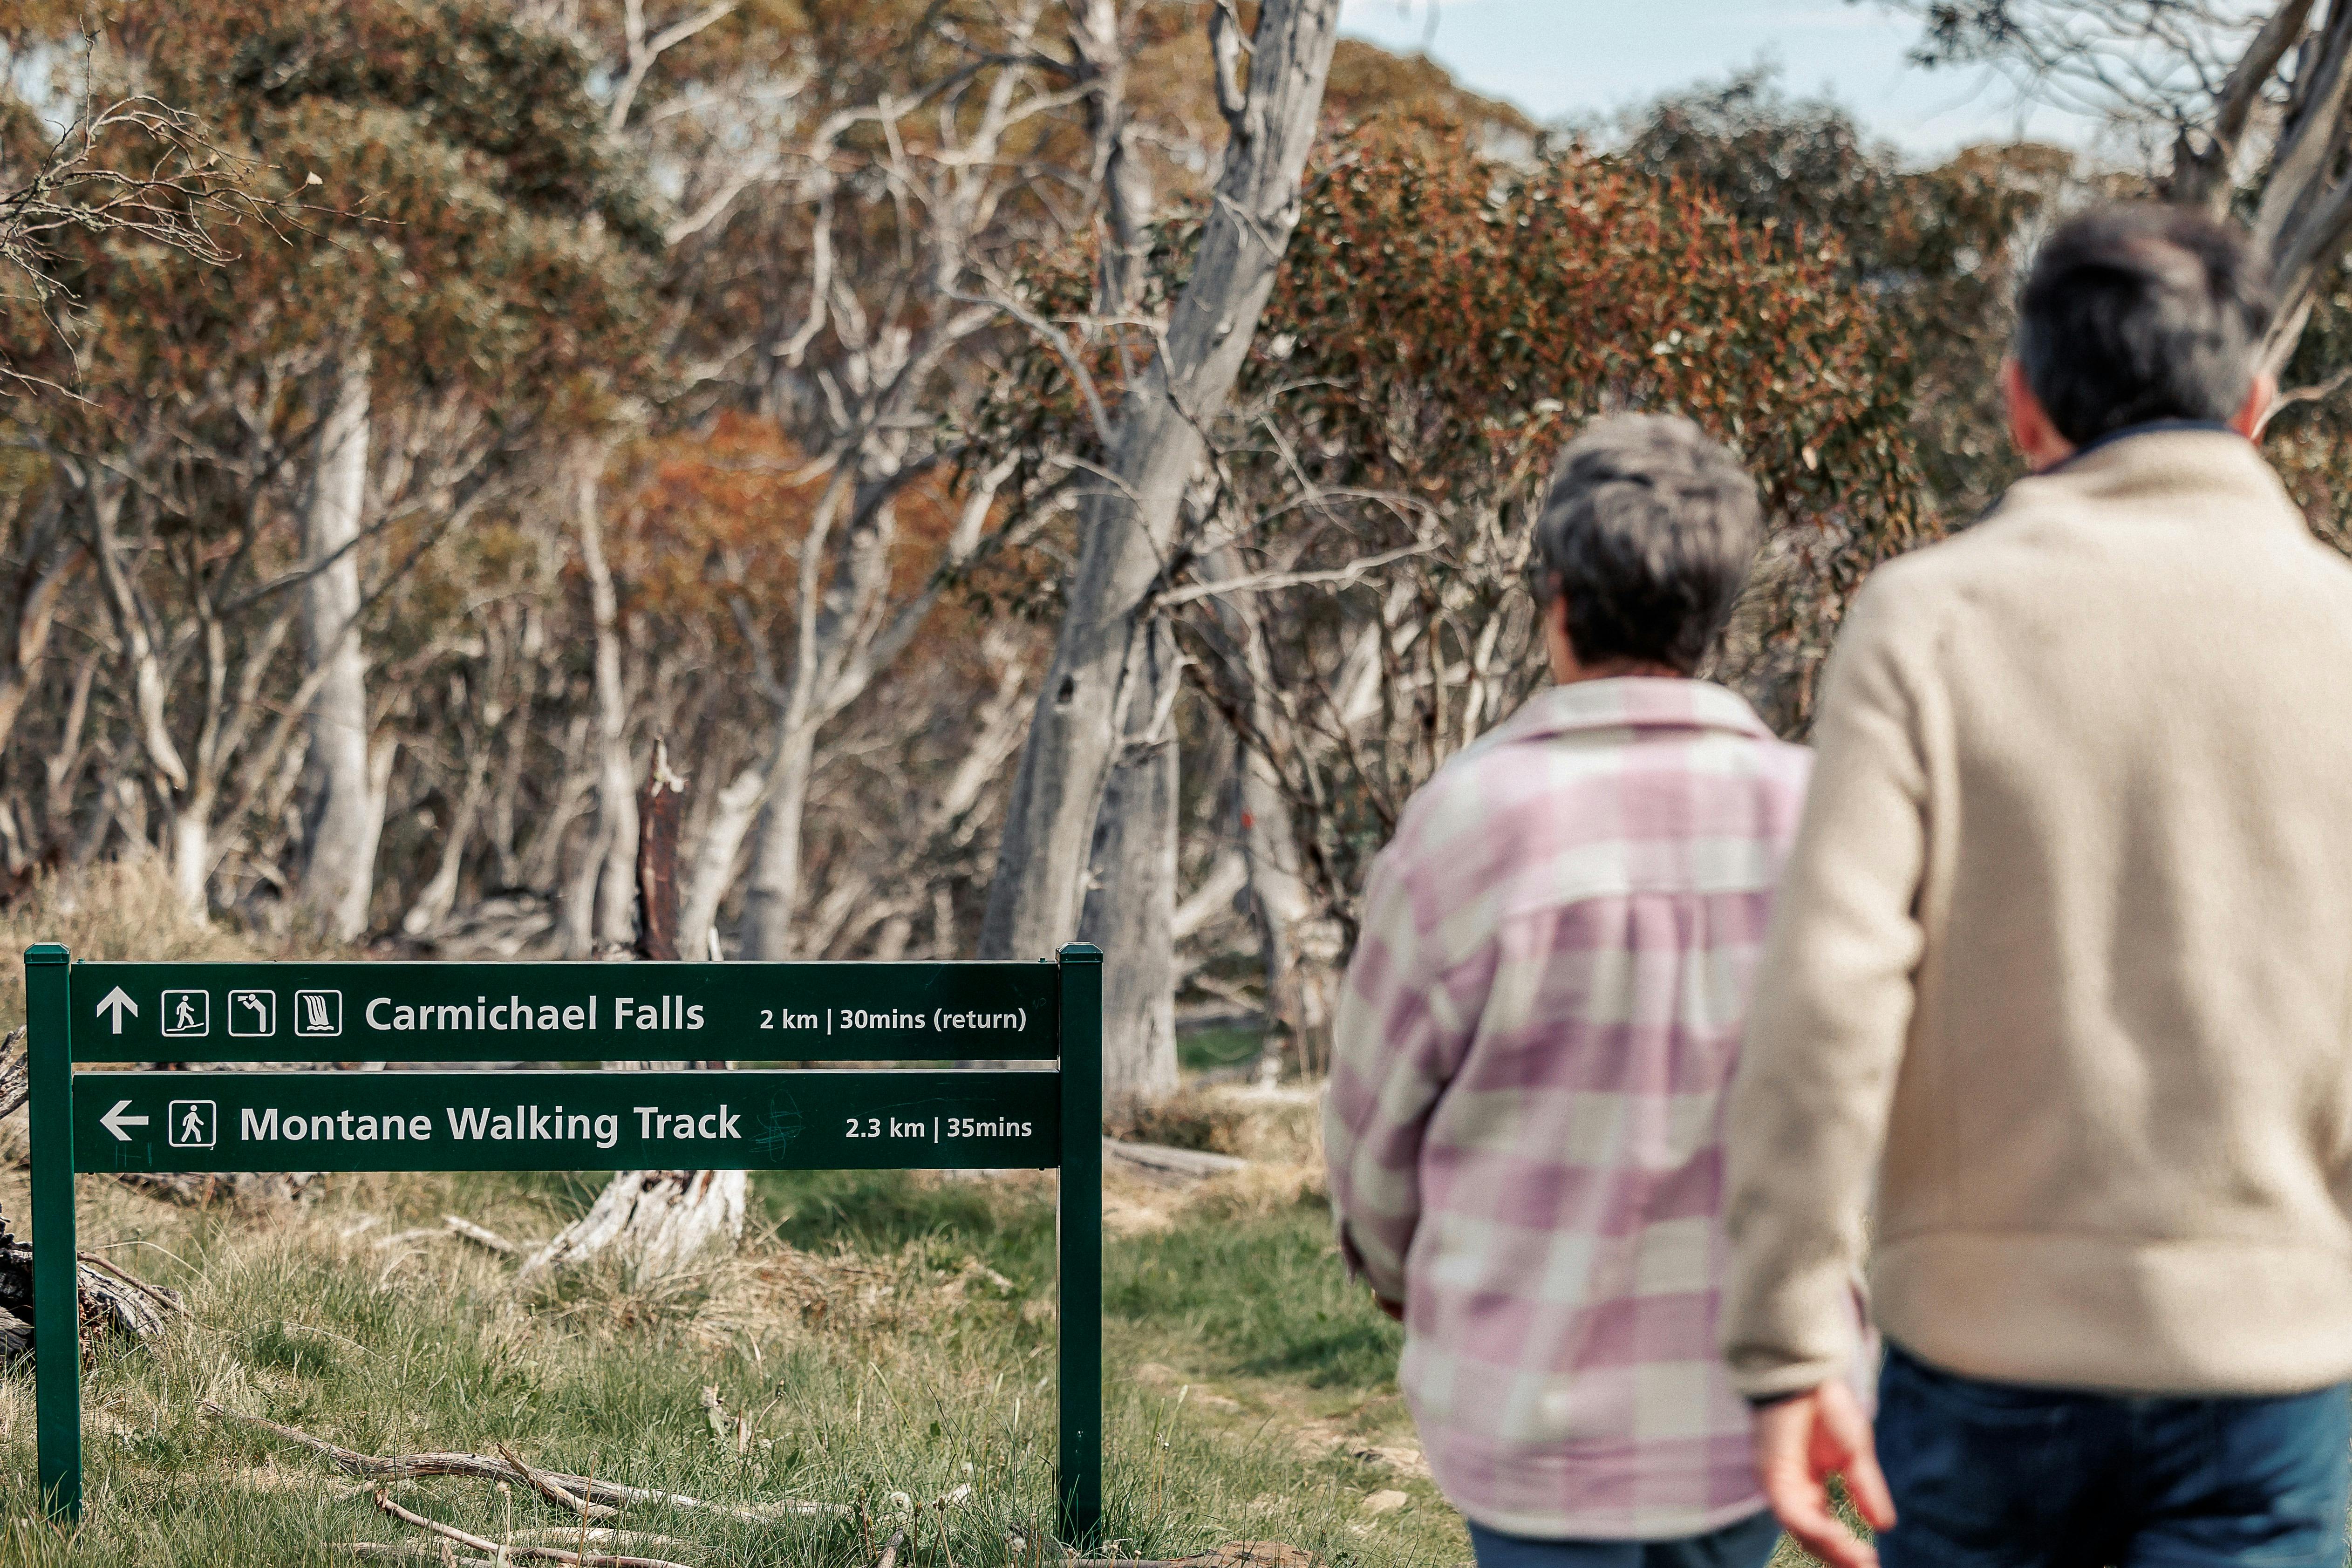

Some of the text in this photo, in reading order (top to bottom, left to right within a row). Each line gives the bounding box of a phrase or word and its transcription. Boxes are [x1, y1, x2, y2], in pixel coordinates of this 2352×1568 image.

[365, 995, 705, 1031] Carmichael Falls
[759, 1009, 774, 1029] 2
[783, 1008, 818, 1029] km
[840, 1008, 925, 1029] 30mins
[933, 1007, 1027, 1033] (return)
[241, 1108, 432, 1141] Montane
[445, 1104, 618, 1149] Walking
[633, 1104, 743, 1139] Track
[845, 1118, 881, 1138] 2.3
[890, 1117, 925, 1138] km
[947, 1116, 1032, 1138] 35mins
